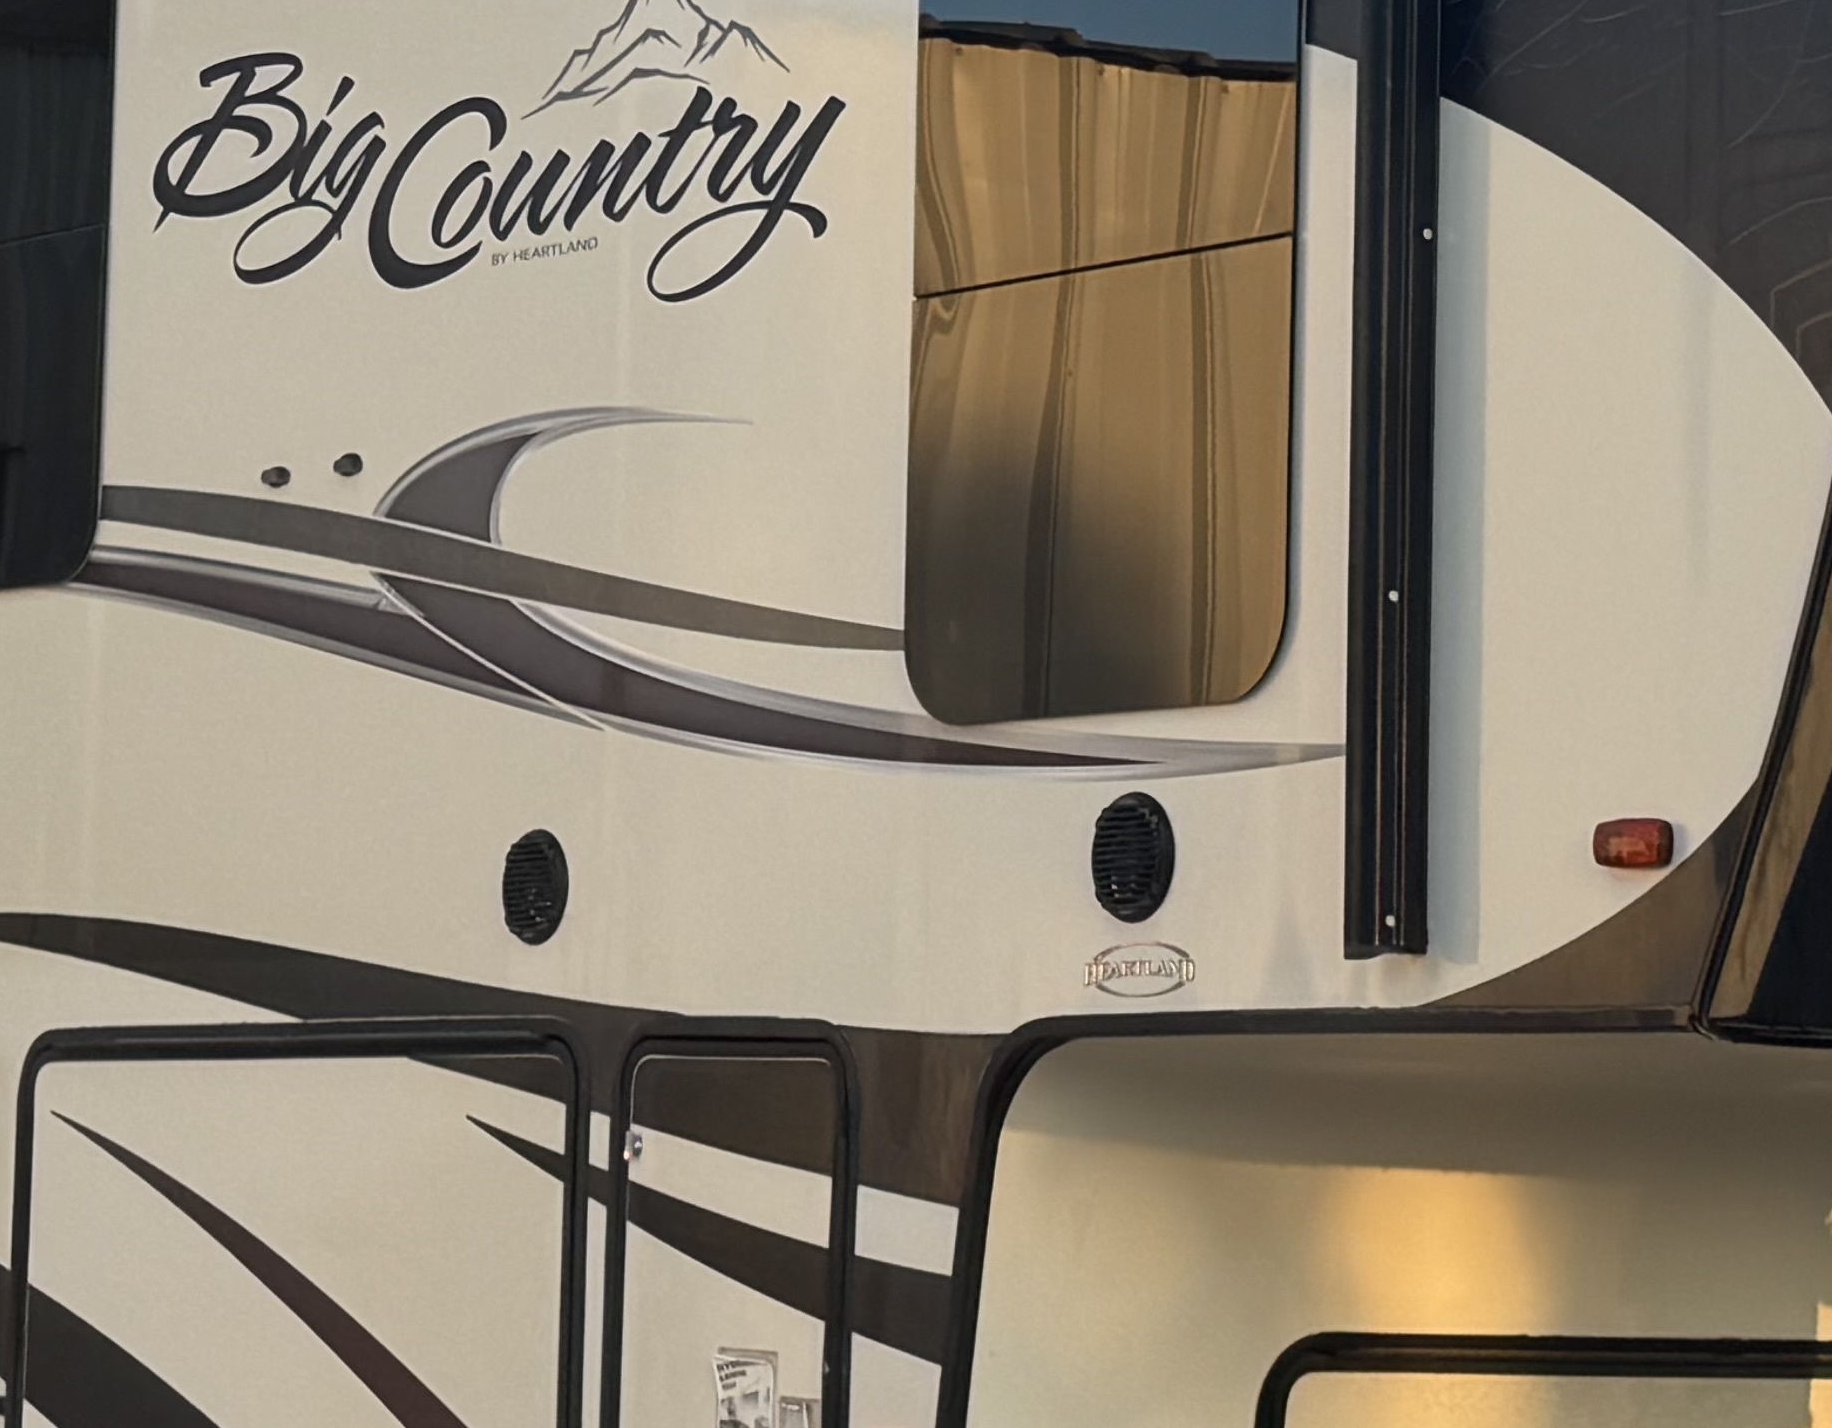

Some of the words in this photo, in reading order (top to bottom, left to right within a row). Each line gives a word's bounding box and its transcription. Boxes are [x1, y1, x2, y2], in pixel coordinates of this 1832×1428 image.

[153, 52, 386, 284] Big
[368, 85, 847, 303] Country
[491, 252, 509, 267] BY
[513, 237, 598, 262] HEARTLAND
[1084, 959, 1195, 986] HEARTLAND
